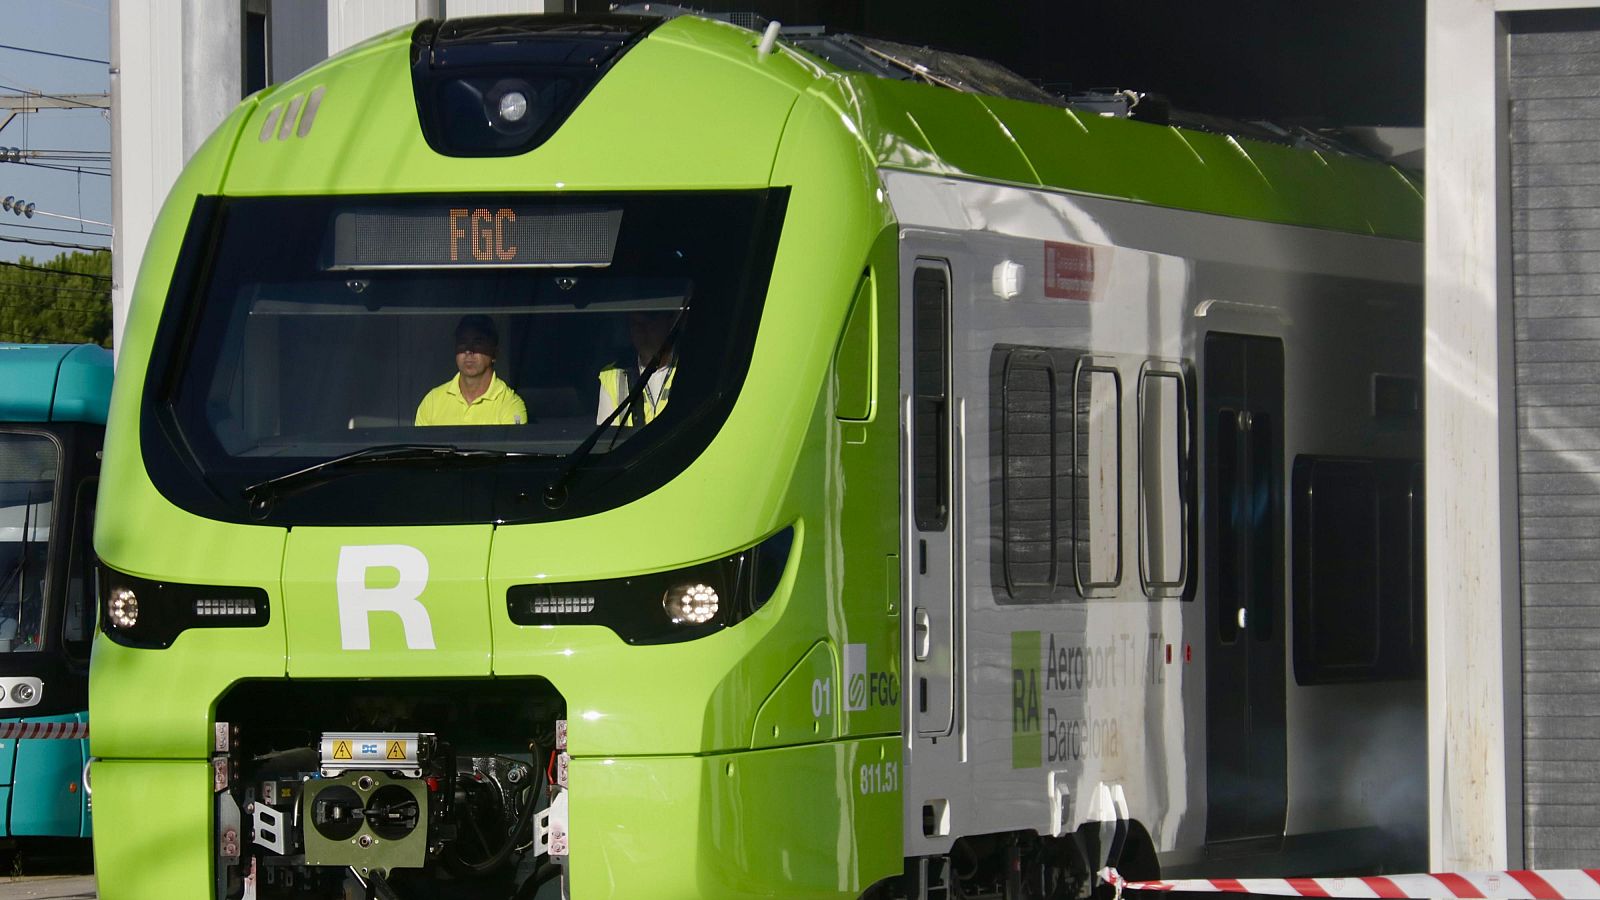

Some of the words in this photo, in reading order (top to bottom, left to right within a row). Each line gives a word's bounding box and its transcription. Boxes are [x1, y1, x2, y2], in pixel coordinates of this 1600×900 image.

[450, 207, 517, 261] FGC
[336, 544, 437, 650] R
[869, 671, 898, 707] FGC
[1046, 633, 1117, 691] Aeroport
[1120, 633, 1136, 687] T1
[811, 677, 831, 718] 01
[1012, 668, 1040, 733] RA
[1047, 706, 1119, 763] Barcelona
[860, 761, 898, 796] 811.51
